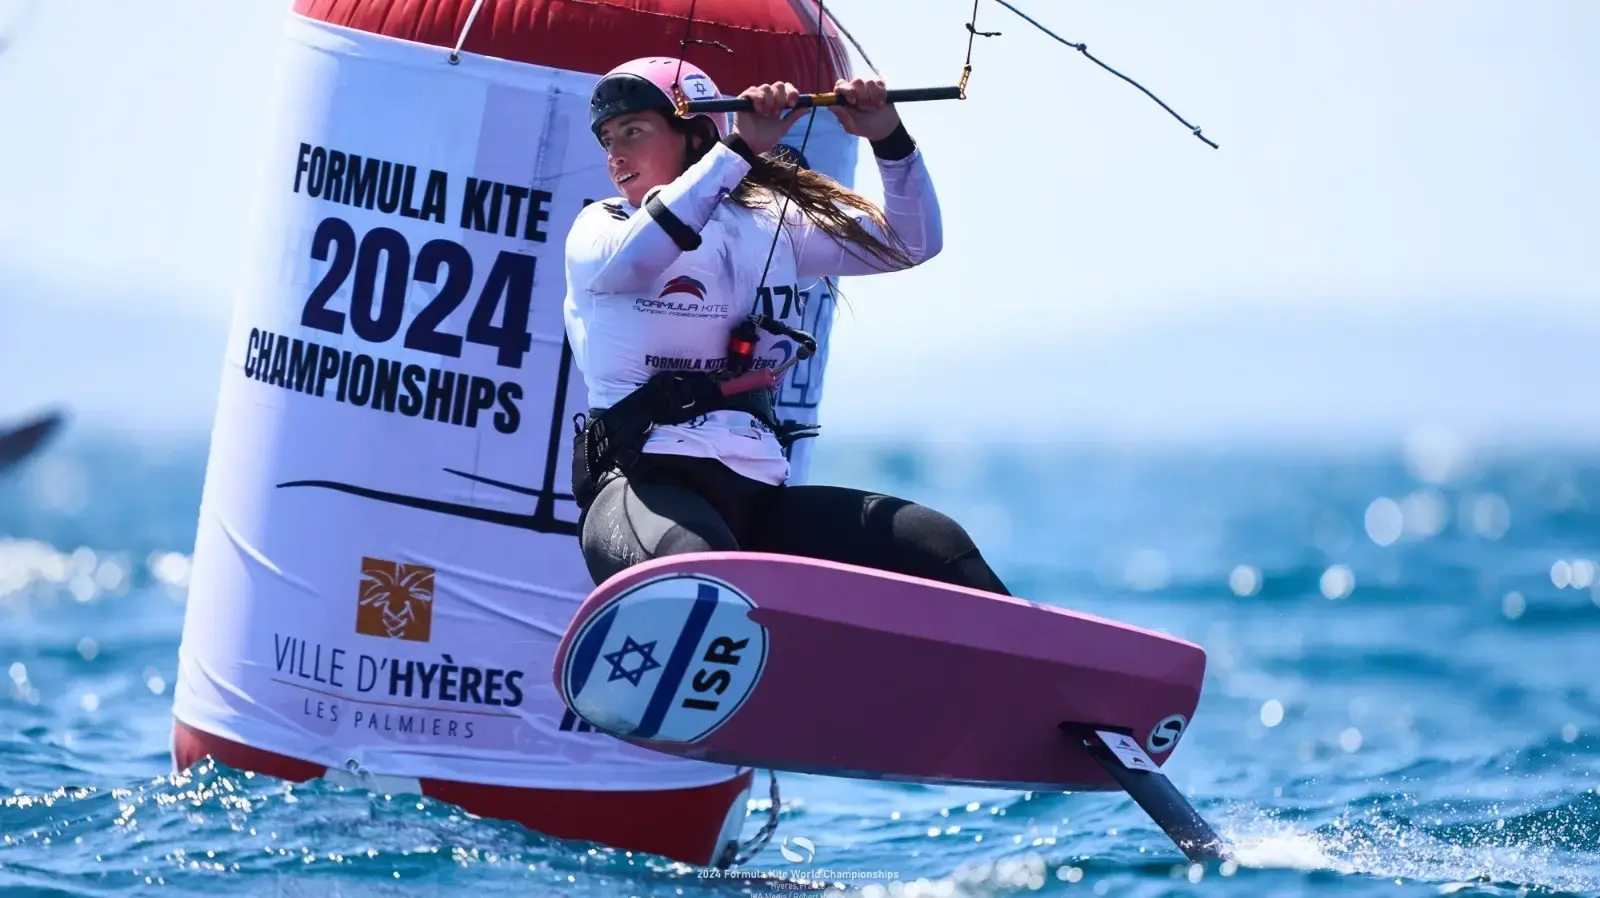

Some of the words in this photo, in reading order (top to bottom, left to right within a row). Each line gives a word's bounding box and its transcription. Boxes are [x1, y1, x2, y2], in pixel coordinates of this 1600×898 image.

[293, 142, 448, 224] FORMULA
[460, 177, 552, 242] KITE
[301, 217, 537, 369] 2024
[635, 298, 698, 311] FORMULA
[701, 304, 728, 313] KITE
[244, 328, 523, 434] CHAMPIONSHIPS
[645, 354, 702, 369] FORMULA
[704, 357, 727, 370] KITE
[274, 633, 346, 688] VILLE
[357, 653, 524, 707] D'HYÈRES
[681, 636, 749, 711] ISR
[304, 698, 338, 722] LES
[354, 711, 474, 738] PALMIERS
